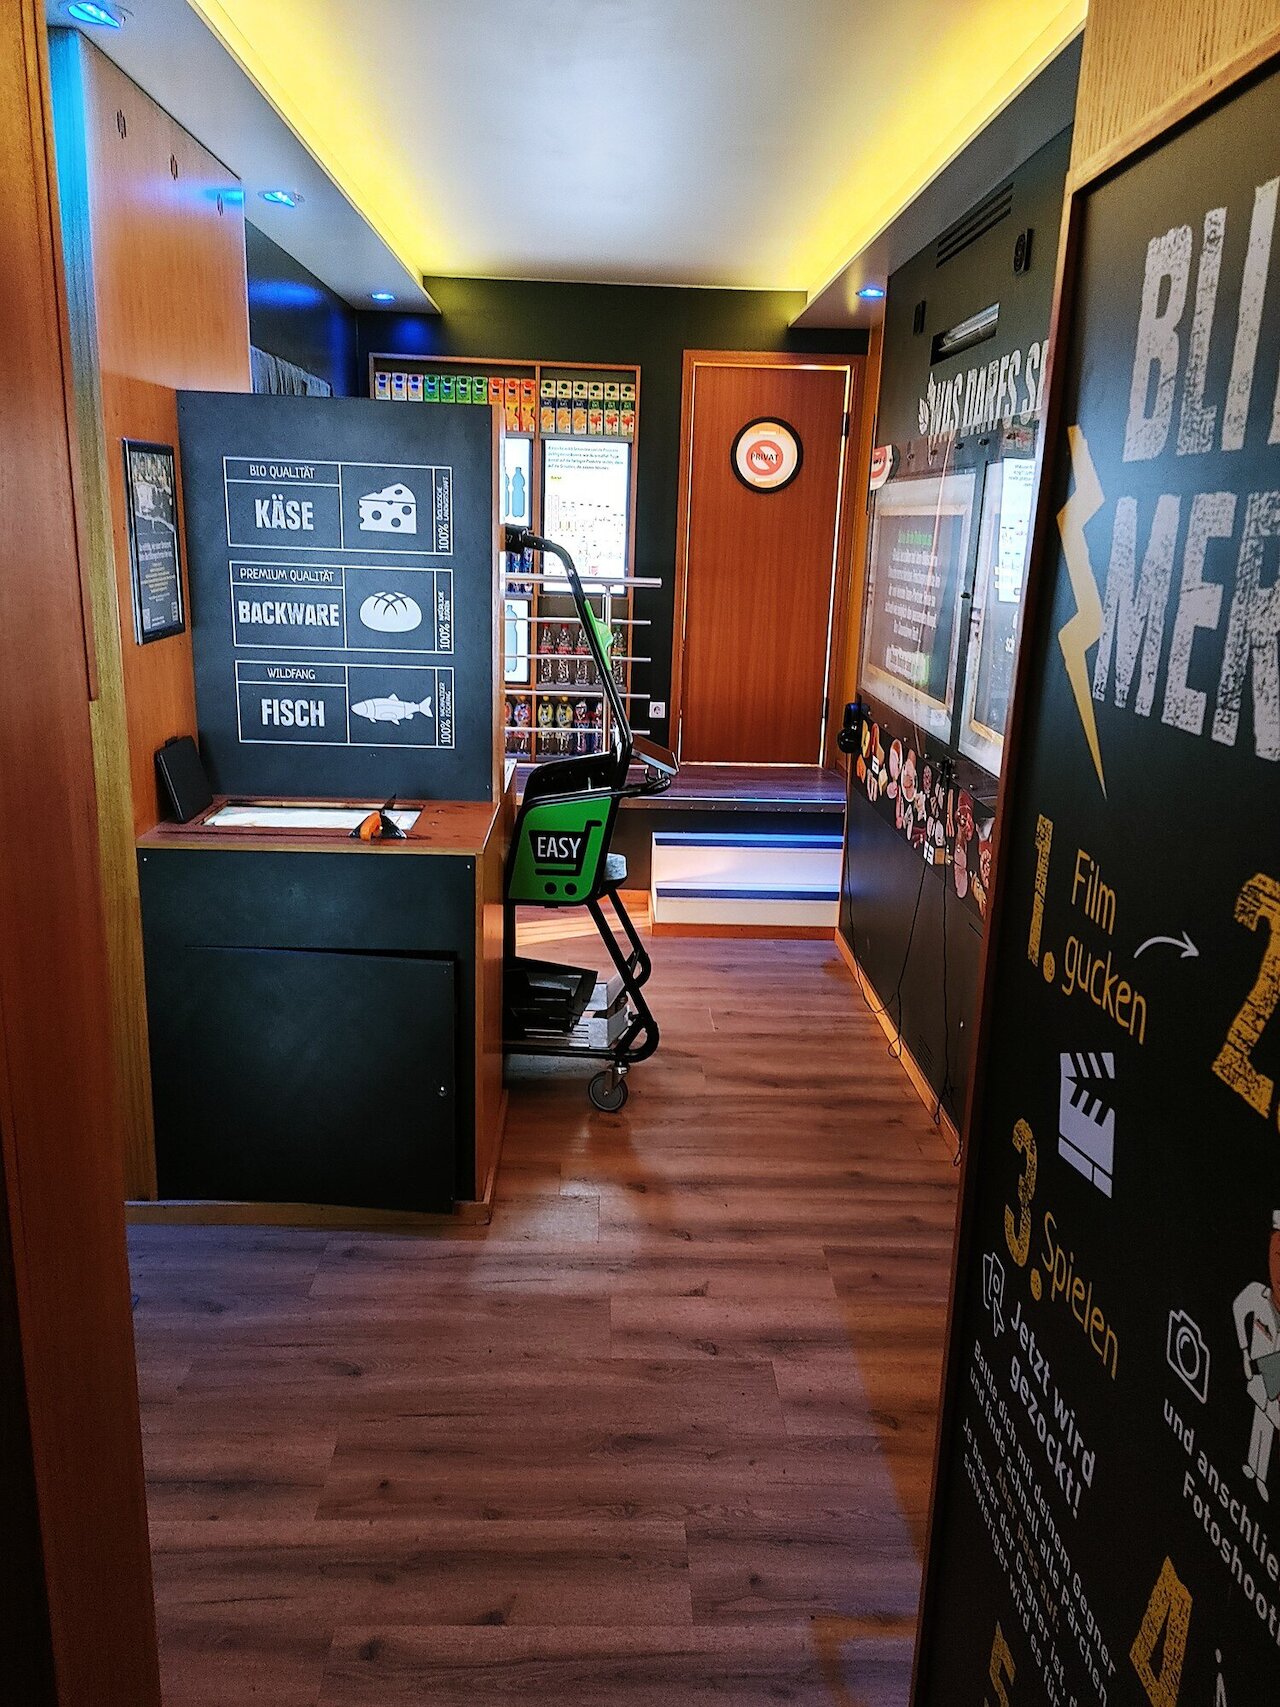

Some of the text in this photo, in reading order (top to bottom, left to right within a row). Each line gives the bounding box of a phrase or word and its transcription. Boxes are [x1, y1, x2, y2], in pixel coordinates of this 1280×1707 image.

[1123, 175, 1280, 462] BLI
[249, 465, 315, 479] BIO QUALITÄT
[255, 494, 314, 530] KÄSE
[750, 453, 779, 461] PRIVAT
[240, 568, 334, 582] PREMIUM QUALITÄT
[438, 523, 449, 550] 100%
[238, 600, 340, 627] BACKWARE
[439, 623, 450, 650] 100%
[261, 698, 325, 727] FISCH
[267, 667, 315, 680] WILDFANG
[440, 719, 451, 744] 100%
[537, 836, 581, 859] EASY
[1028, 813, 1056, 983] 1.
[1071, 848, 1118, 936] Film
[1061, 934, 1148, 1046] gucken
[1212, 872, 1280, 1134] 2
[1004, 1117, 1118, 1380] 3. Spielen
[1010, 1355, 1081, 1520] gezockt!
[1011, 1301, 1095, 1488] Jetzt wird
[970, 1367, 985, 1406] und
[985, 1400, 1006, 1457] finde
[1006, 1456, 1039, 1541] schnell
[1040, 1538, 1060, 1590] alle
[1060, 1584, 1107, 1707] Pärchen
[974, 1339, 1117, 1677] Battle dich mit deinem Gegner
[996, 1466, 1060, 1634] Aber pass auf:
[1164, 1398, 1280, 1592] und anschlie
[963, 1417, 1067, 1697] Je besser der Gegner ist,
[963, 1453, 1009, 1573] schwieriger
[1009, 1573, 1030, 1633] wird
[1030, 1633, 1042, 1668] es
